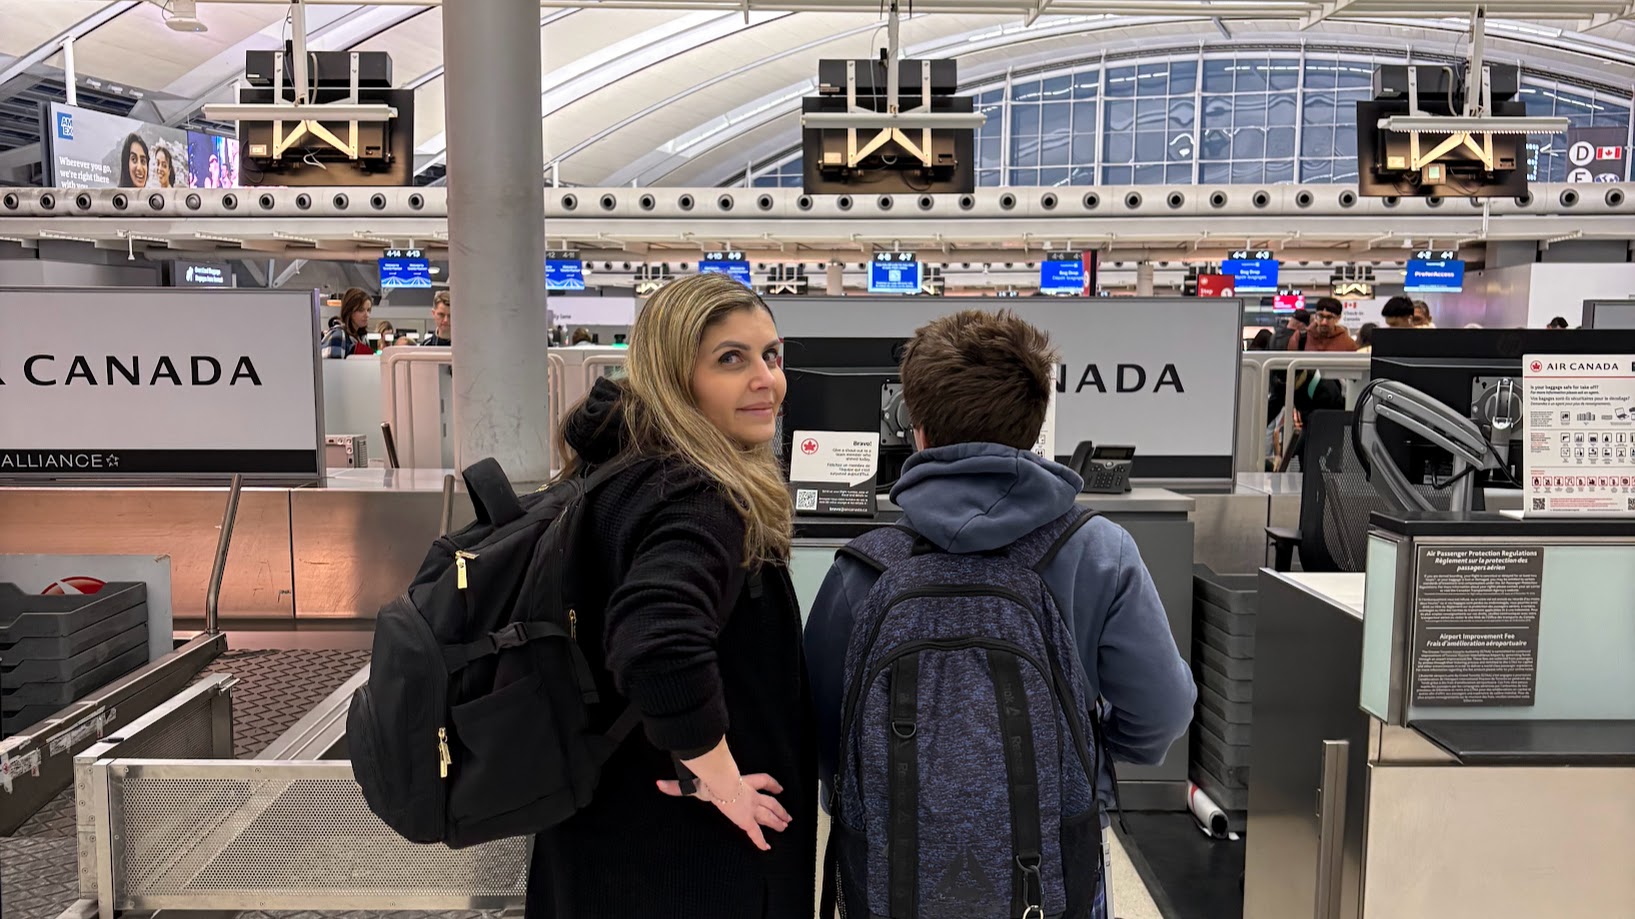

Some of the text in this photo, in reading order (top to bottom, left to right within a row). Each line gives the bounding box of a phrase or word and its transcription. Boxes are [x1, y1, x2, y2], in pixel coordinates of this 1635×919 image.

[1576, 146, 1589, 161] D
[59, 156, 112, 174] Wherever you go,
[60, 170, 110, 184] we're right there
[61, 180, 76, 188] with
[707, 252, 742, 260] 4-10 4-9
[1232, 251, 1270, 260] 4-4 4-3
[1417, 251, 1453, 259] 4-2 4-1
[24, 354, 262, 386] CANADA
[1546, 362, 1619, 371] AIR CANADA
[2, 454, 103, 468] ALLIANCE
[1436, 550, 1467, 558] Passenger
[1501, 550, 1538, 558] Regulations
[1435, 557, 1468, 566] Règlement
[1484, 557, 1517, 566] protection
[1456, 565, 1486, 573] passagers
[1440, 632, 1516, 641] Airport Improvement Fee
[1486, 640, 1528, 648] aéroportuaire
